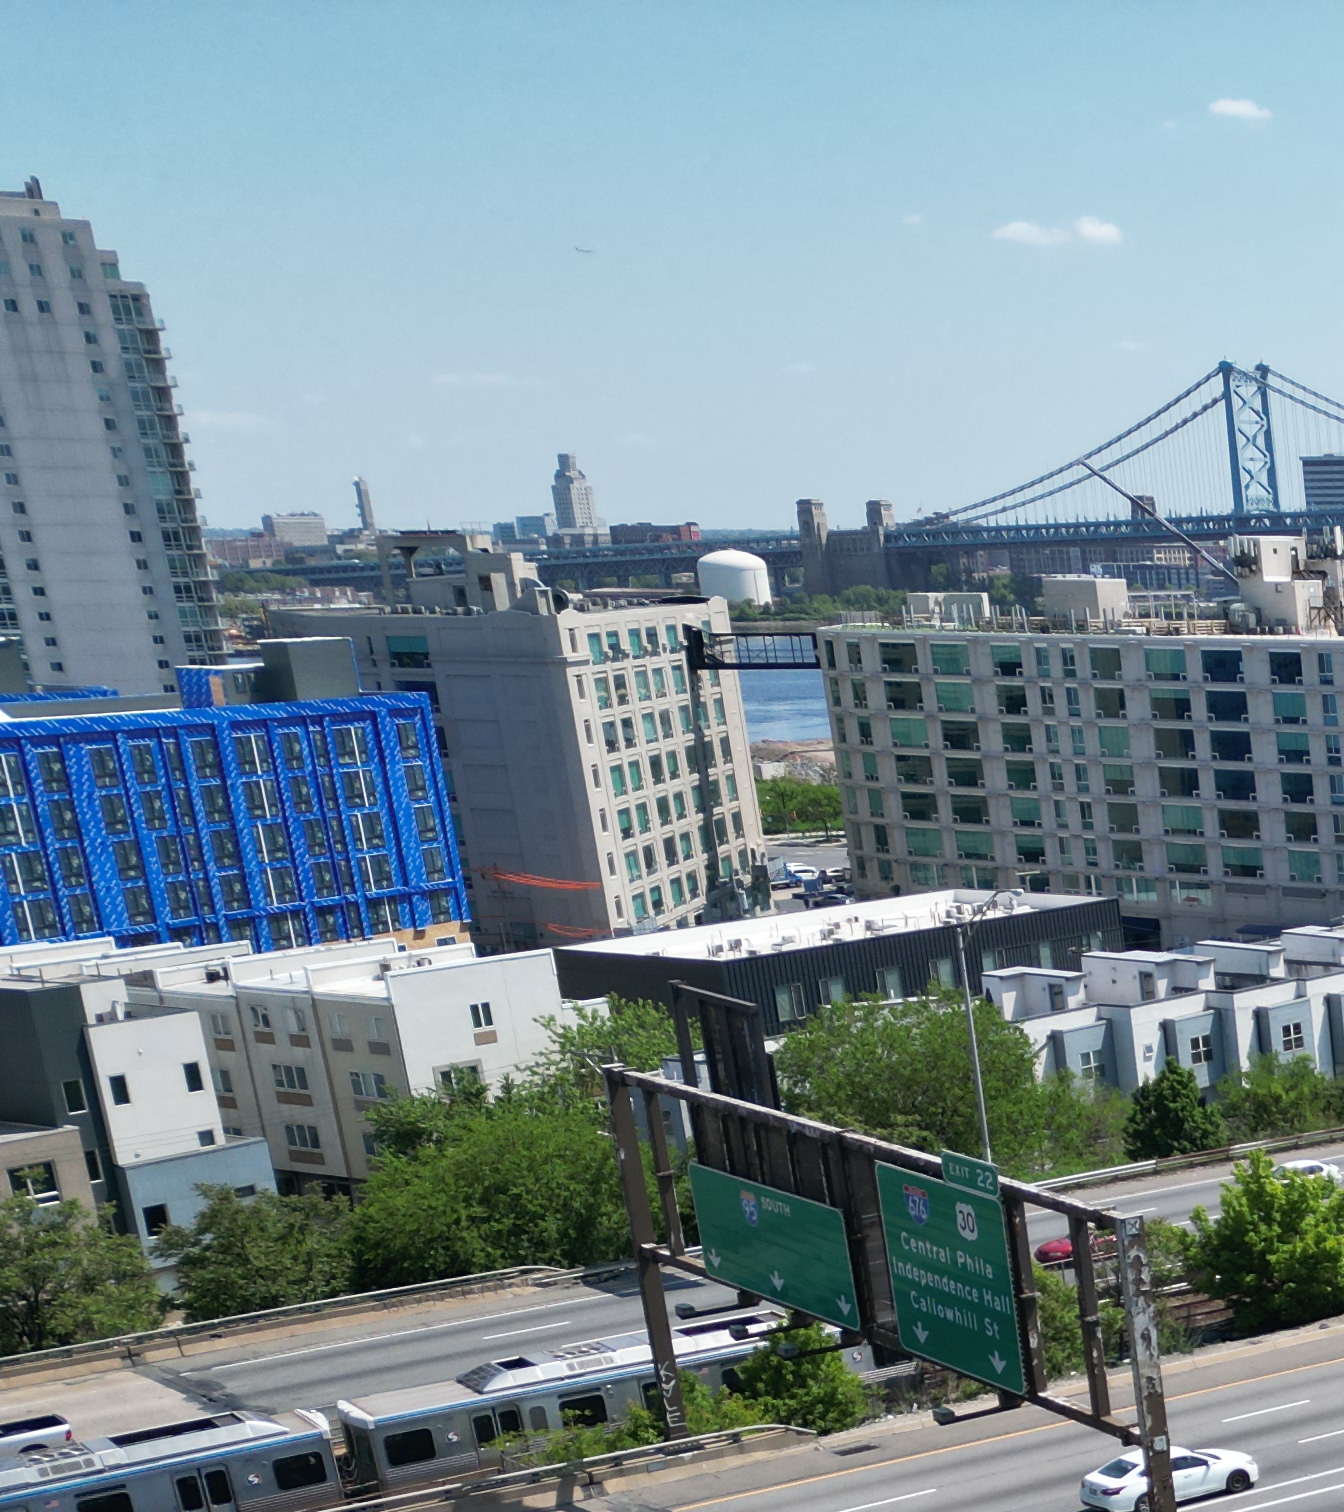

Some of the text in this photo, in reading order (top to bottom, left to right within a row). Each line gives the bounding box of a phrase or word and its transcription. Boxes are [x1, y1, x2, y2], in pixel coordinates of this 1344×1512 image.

[947, 1162, 995, 1190] EXIT 22
[741, 1195, 792, 1220] 95 SOUTH
[907, 1195, 928, 1221] 676
[957, 1210, 977, 1234] 30
[900, 1230, 994, 1280] Central Phila
[893, 1256, 1011, 1316] Independence Hall
[909, 1290, 1001, 1341] Callowhill St
